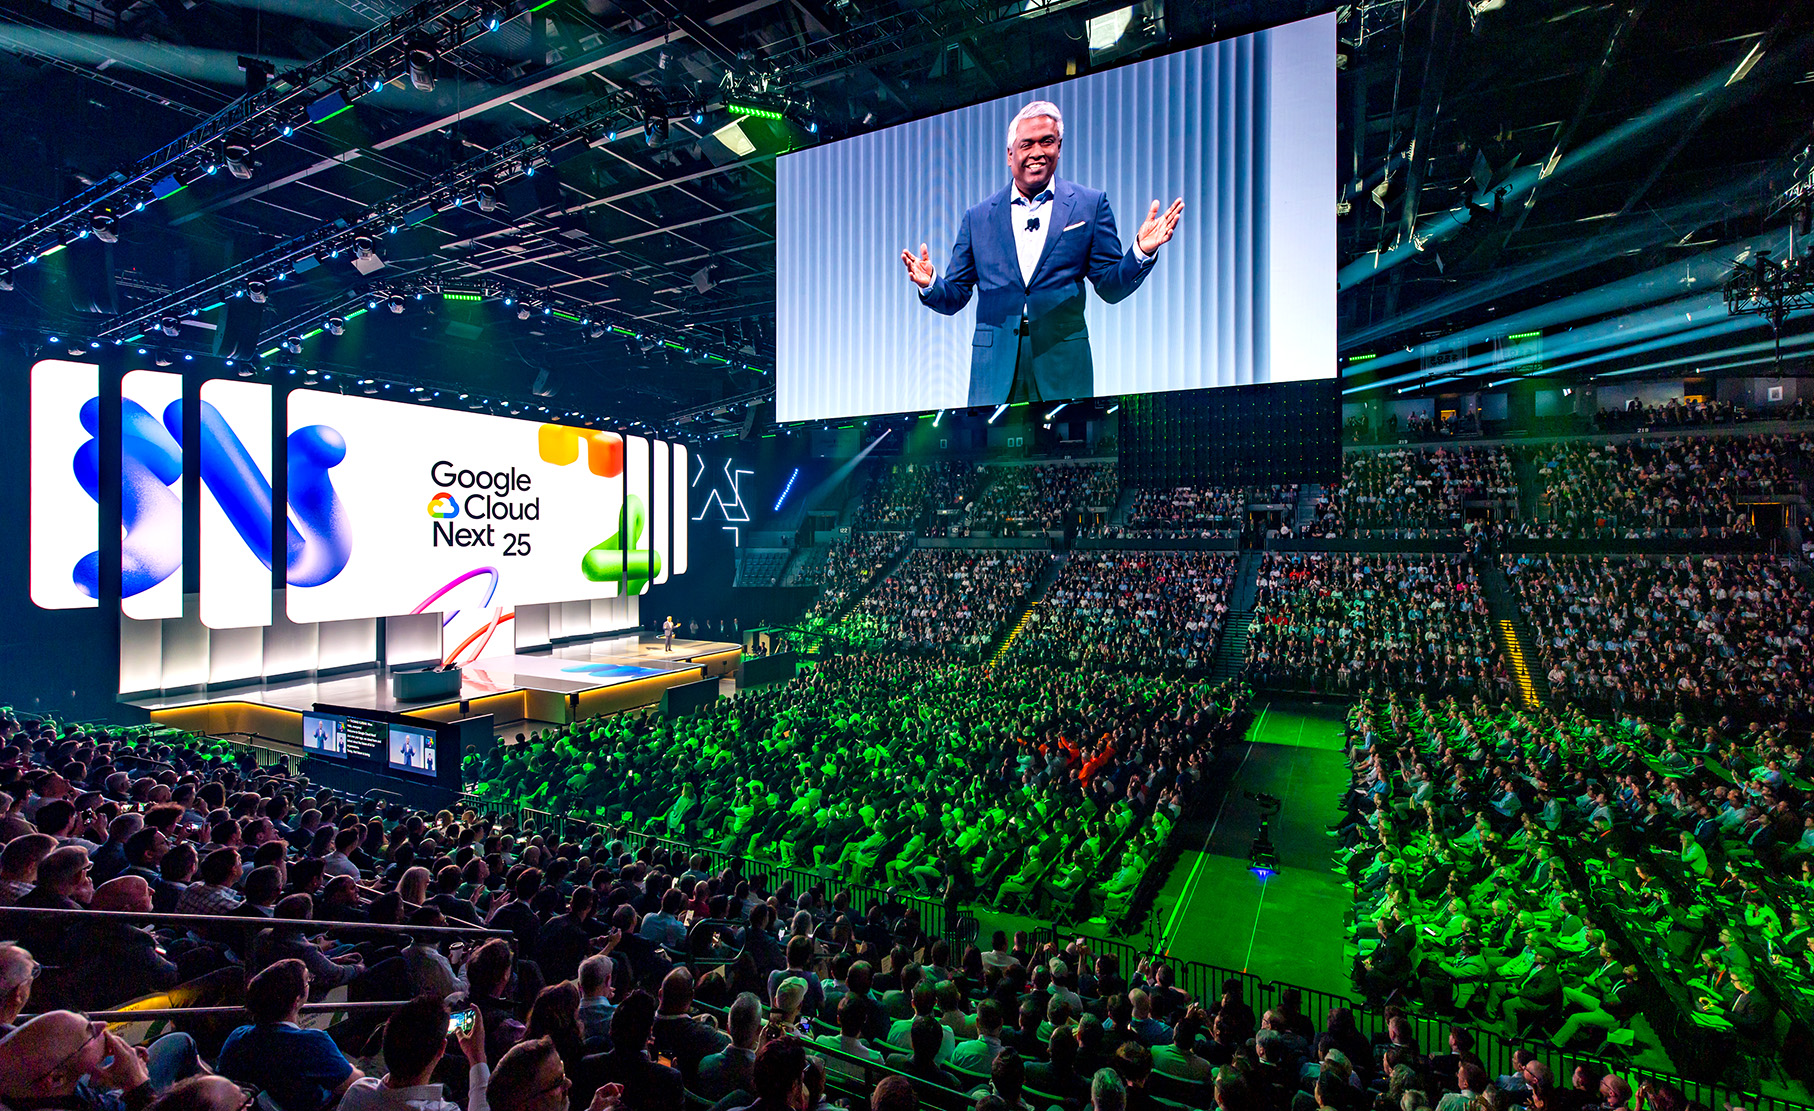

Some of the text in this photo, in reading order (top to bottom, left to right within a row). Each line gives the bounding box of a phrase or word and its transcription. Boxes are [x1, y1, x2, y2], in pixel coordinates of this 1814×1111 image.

[431, 460, 531, 497] Google
[464, 493, 539, 520] Cloud
[433, 521, 531, 556] Next 25
